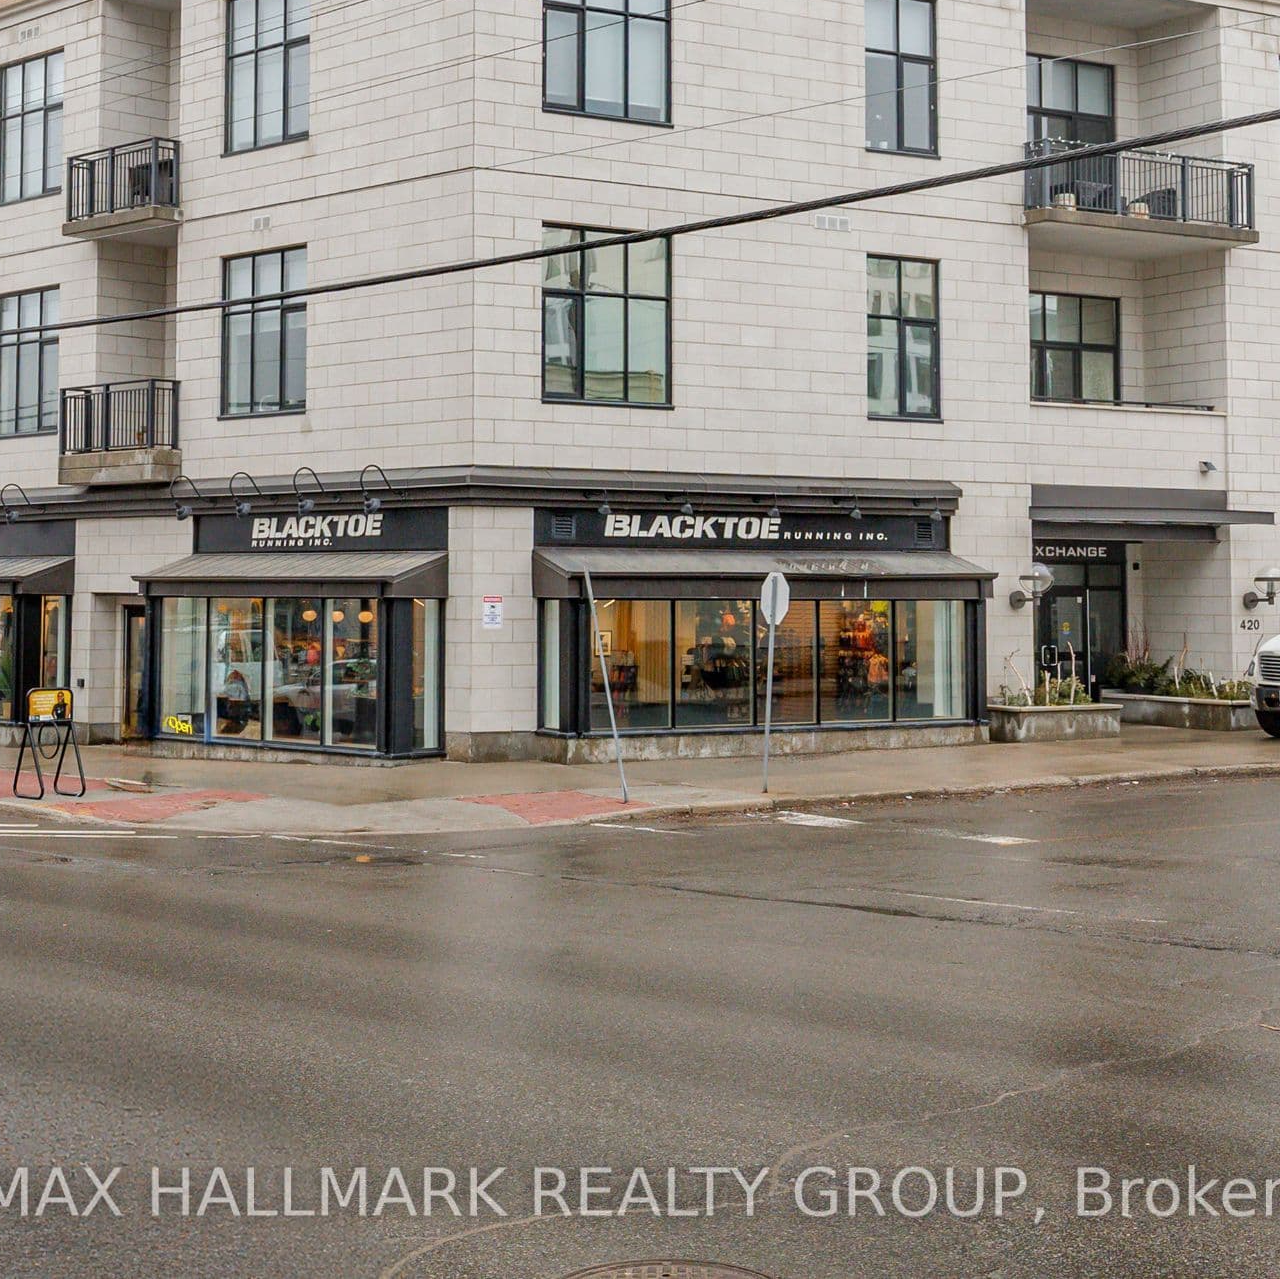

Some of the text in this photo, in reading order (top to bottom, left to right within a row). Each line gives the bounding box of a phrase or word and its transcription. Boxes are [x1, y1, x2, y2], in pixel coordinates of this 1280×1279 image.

[252, 513, 384, 539] BLACKTOE
[604, 515, 889, 541] BLACKTOE RUNNING INC.
[251, 538, 333, 548] RUNNING INC.
[1240, 620, 1260, 631] 420
[168, 716, 193, 735] Open
